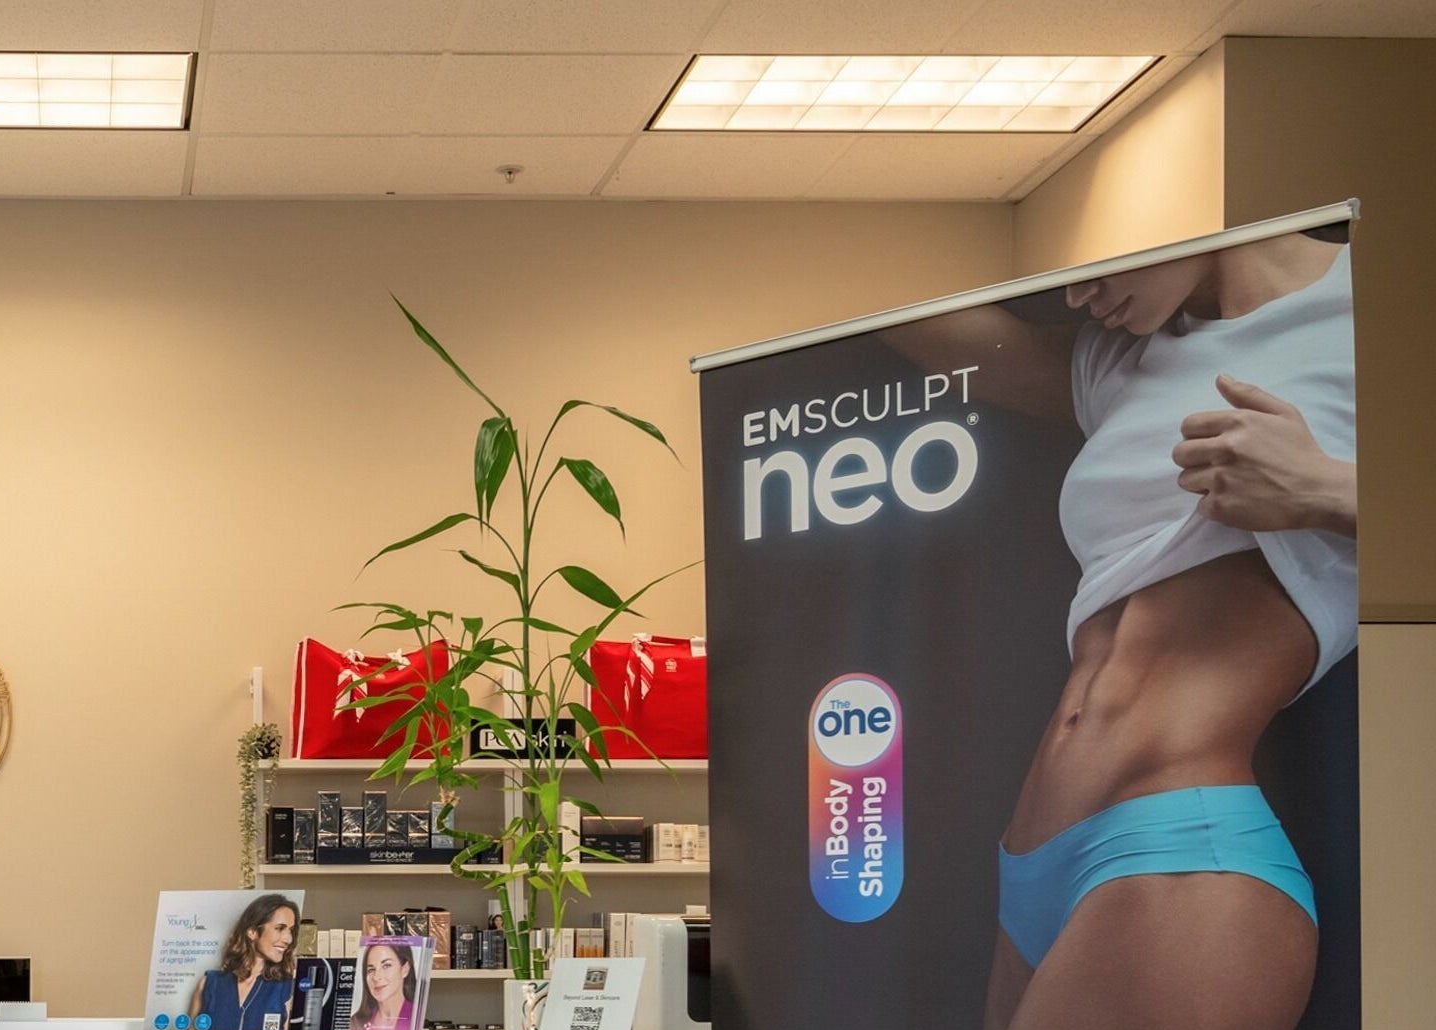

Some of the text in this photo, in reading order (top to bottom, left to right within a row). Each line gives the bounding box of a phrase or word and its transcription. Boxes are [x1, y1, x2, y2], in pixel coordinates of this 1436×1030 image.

[743, 365, 979, 447] EMSCULPT
[830, 699, 851, 709] The
[818, 706, 892, 737] one
[531, 731, 565, 747] skn
[857, 776, 887, 897] Shaping
